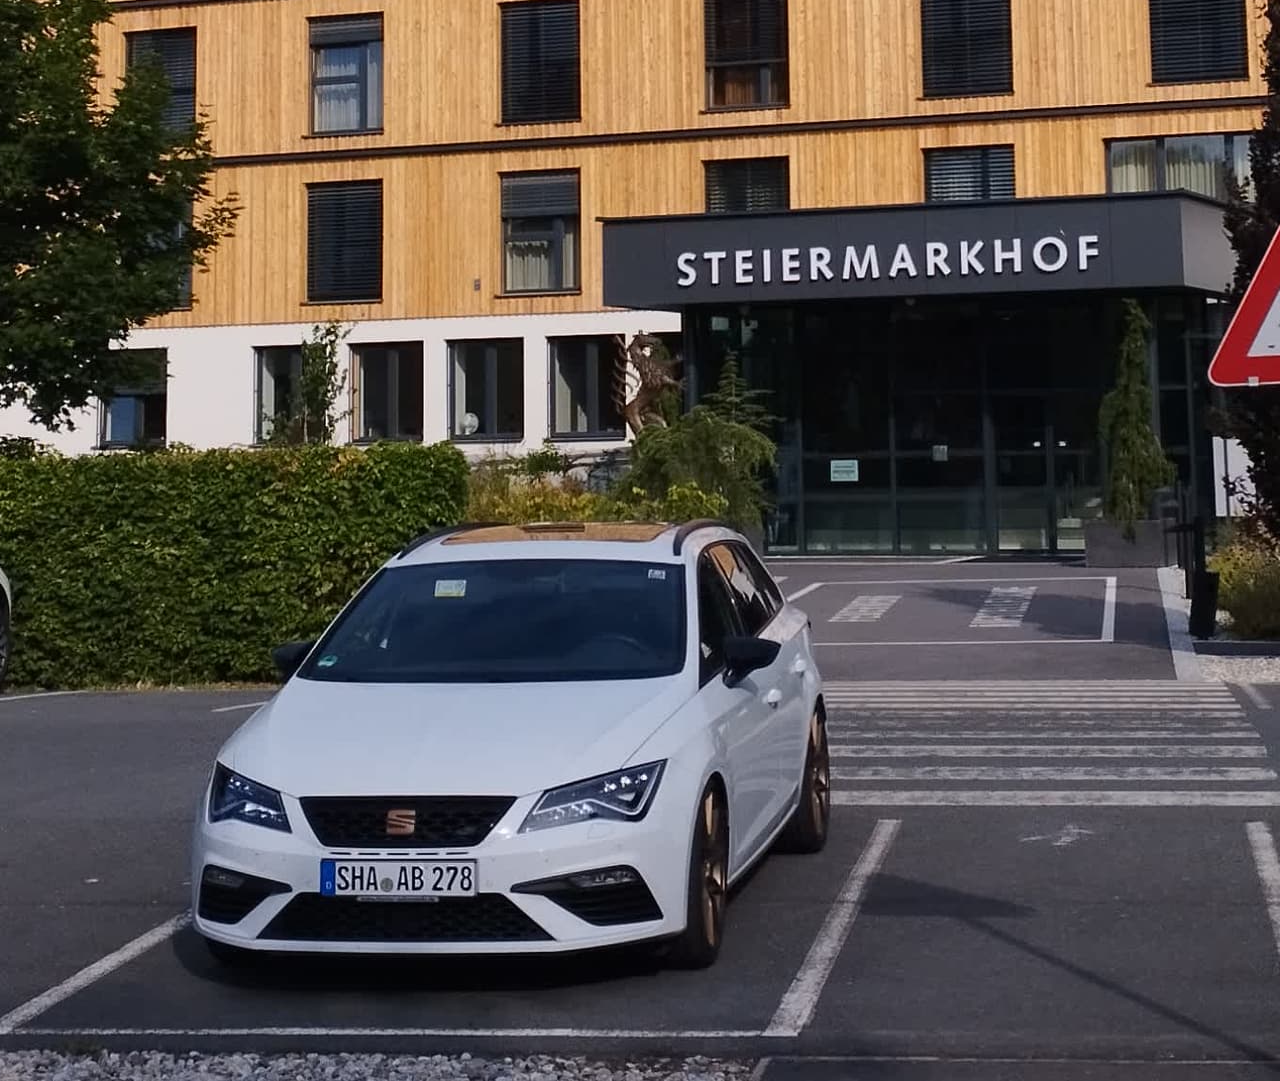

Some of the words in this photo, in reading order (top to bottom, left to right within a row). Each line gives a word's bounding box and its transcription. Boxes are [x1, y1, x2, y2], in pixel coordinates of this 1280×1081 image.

[677, 235, 1100, 287] STEIERMARKHOF
[337, 866, 378, 891] SHA
[396, 866, 424, 891] AB
[432, 866, 472, 891] 278
